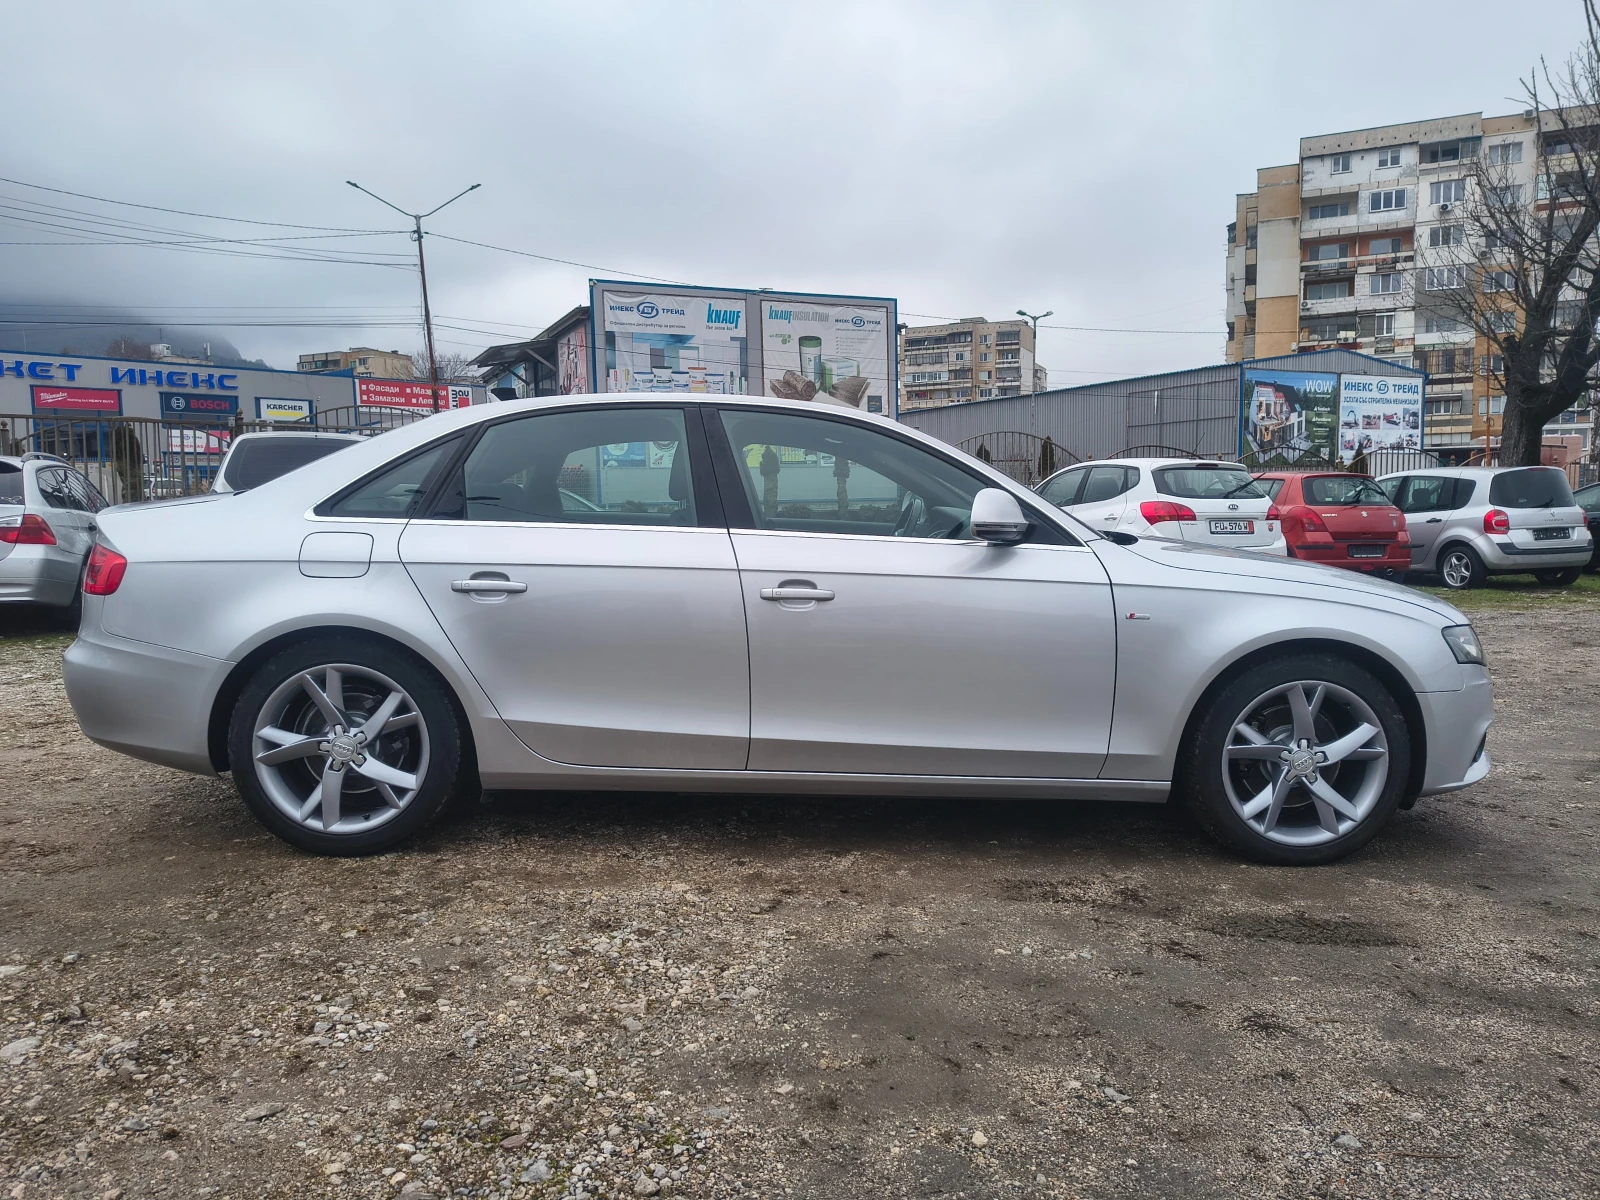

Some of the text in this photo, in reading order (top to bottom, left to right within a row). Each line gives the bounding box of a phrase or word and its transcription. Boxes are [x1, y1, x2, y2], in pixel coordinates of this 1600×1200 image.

[609, 304, 686, 316] ИНЕКС ТРЕЙД
[110, 366, 239, 391] ИНЕКС
[368, 383, 400, 393] Фасади
[1305, 379, 1334, 393] WOW
[1343, 381, 1419, 395] ИНЕКС ТРЕЙД
[369, 393, 406, 403] Замазки
[190, 399, 230, 411] BOSCH
